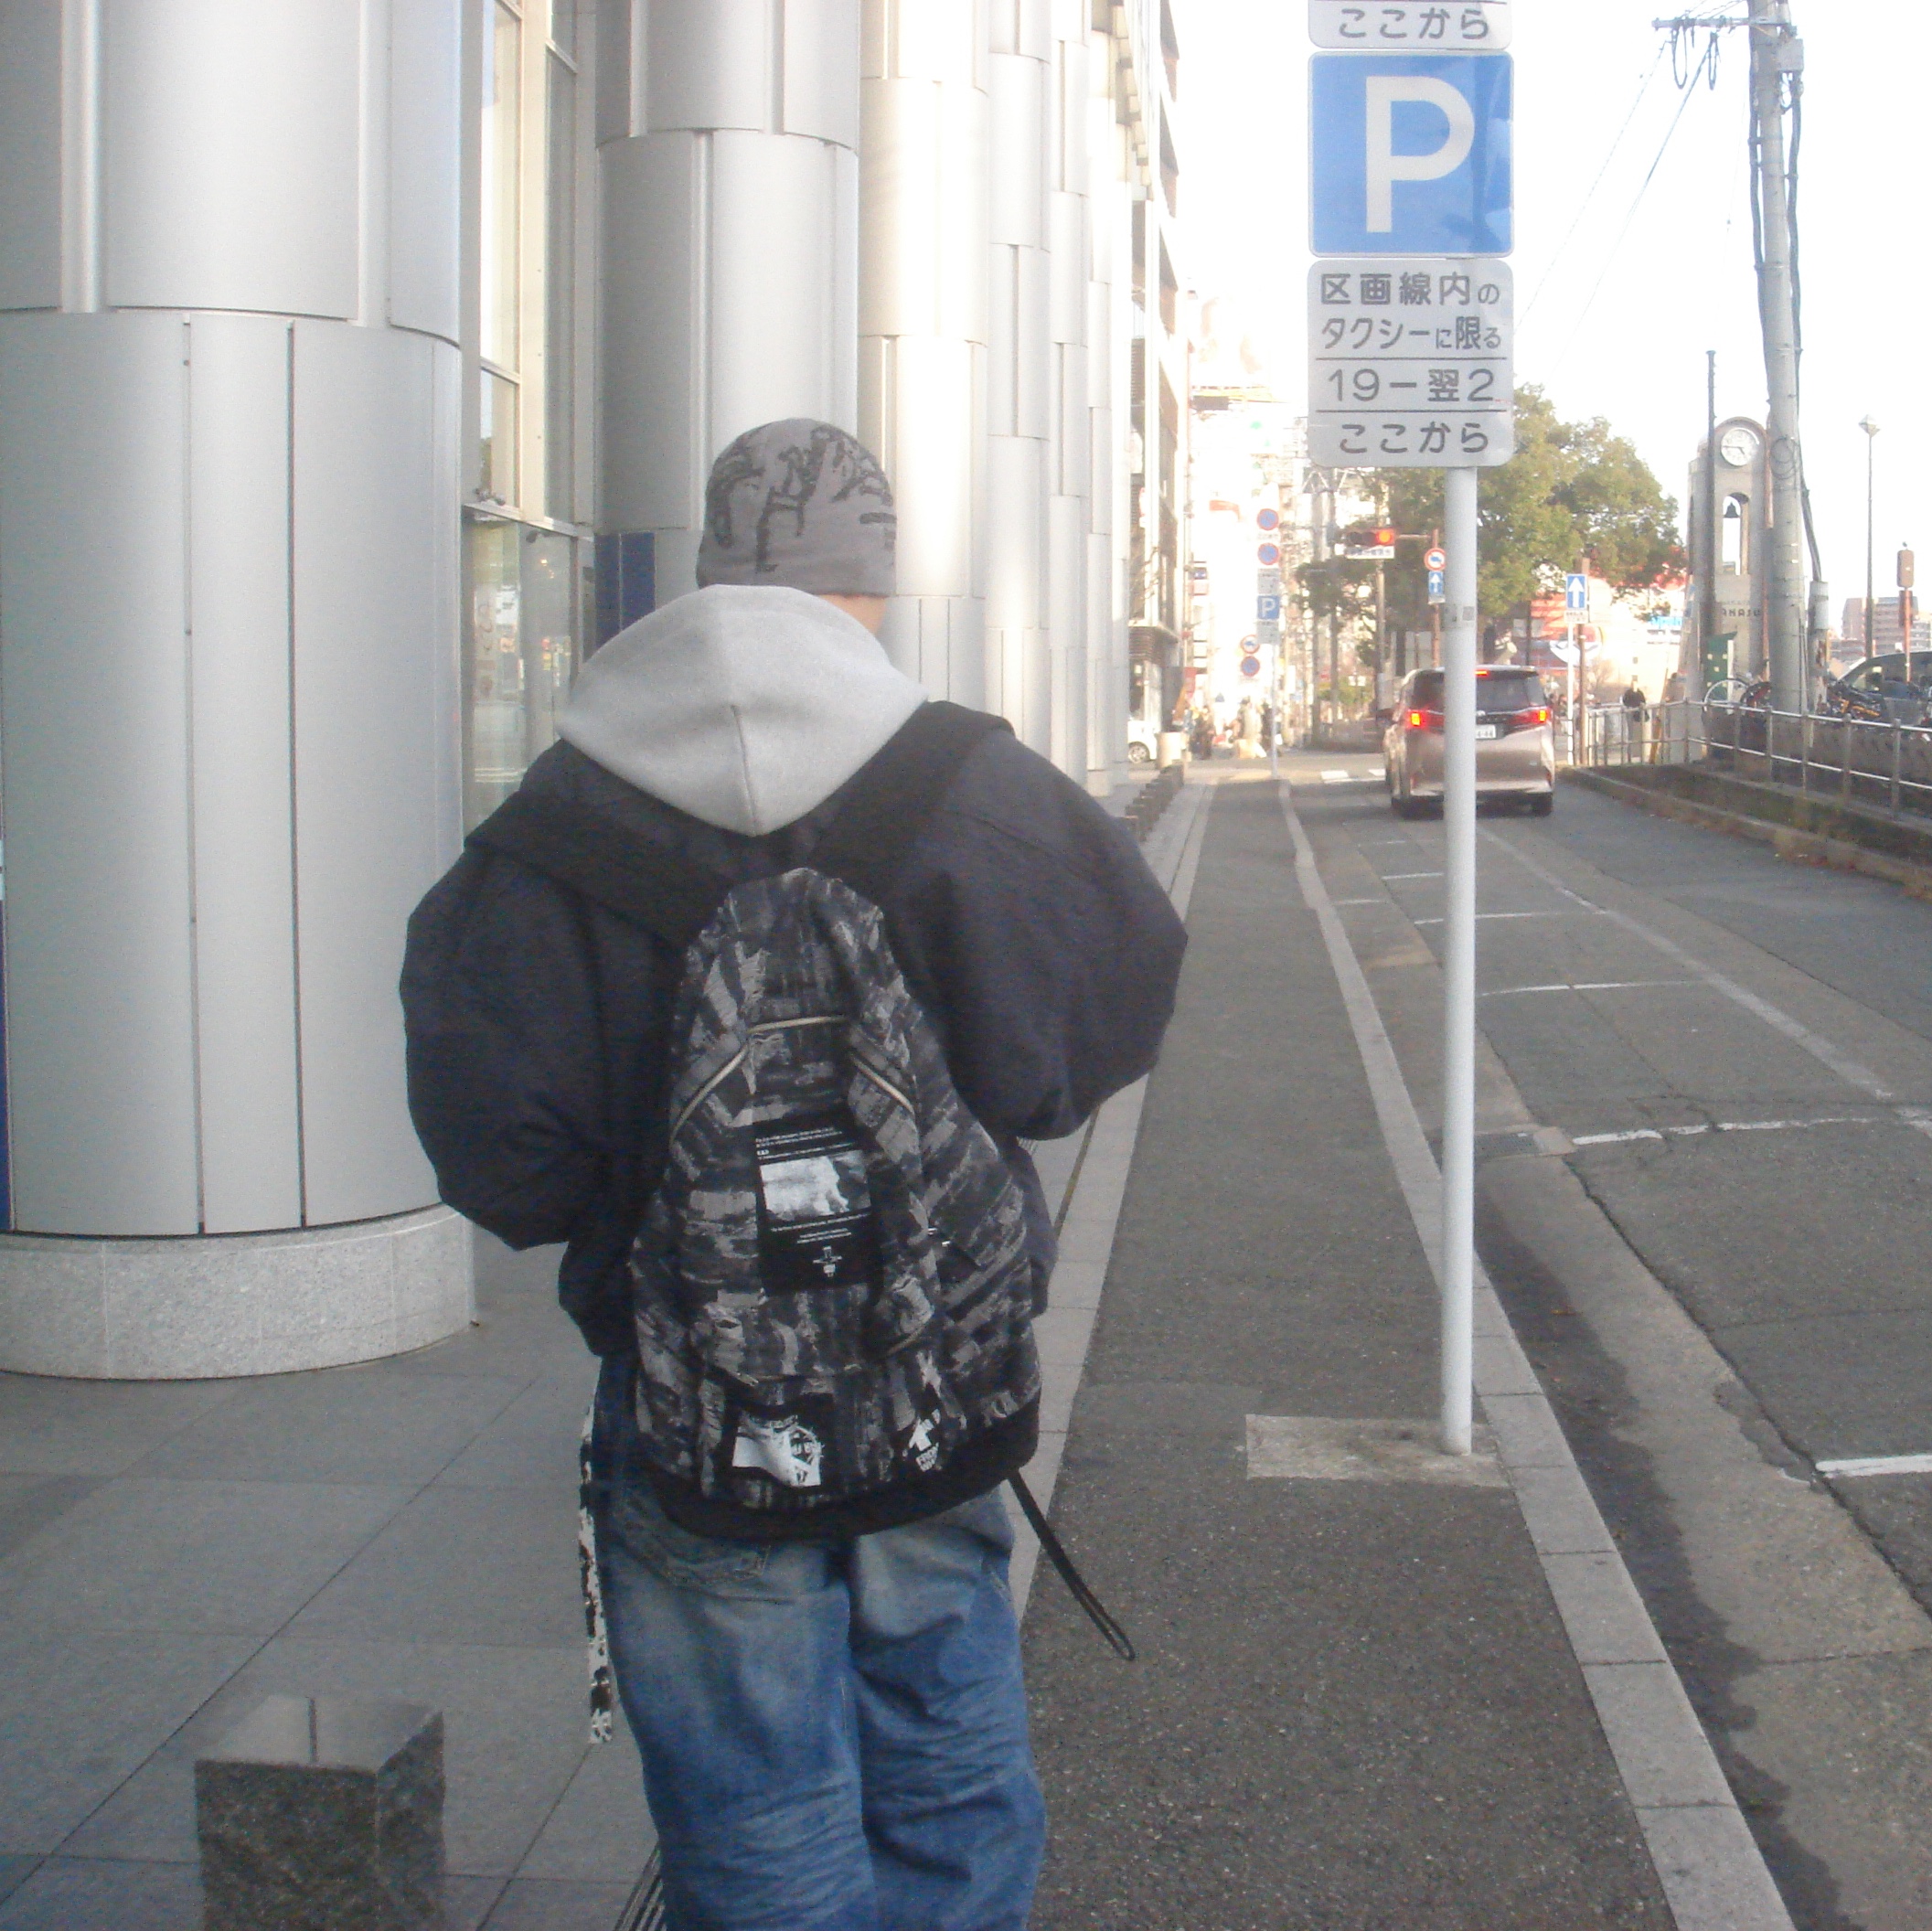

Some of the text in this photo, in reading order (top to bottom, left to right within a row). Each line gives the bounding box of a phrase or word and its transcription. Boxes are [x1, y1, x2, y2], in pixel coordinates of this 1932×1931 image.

[1340, 7, 1489, 39] ここから
[1366, 76, 1475, 233] P
[1321, 272, 1500, 305] 区画線内の
[1321, 316, 1501, 349] タクシーに限る
[1340, 421, 1489, 453] ここから
[1261, 597, 1276, 618] P
